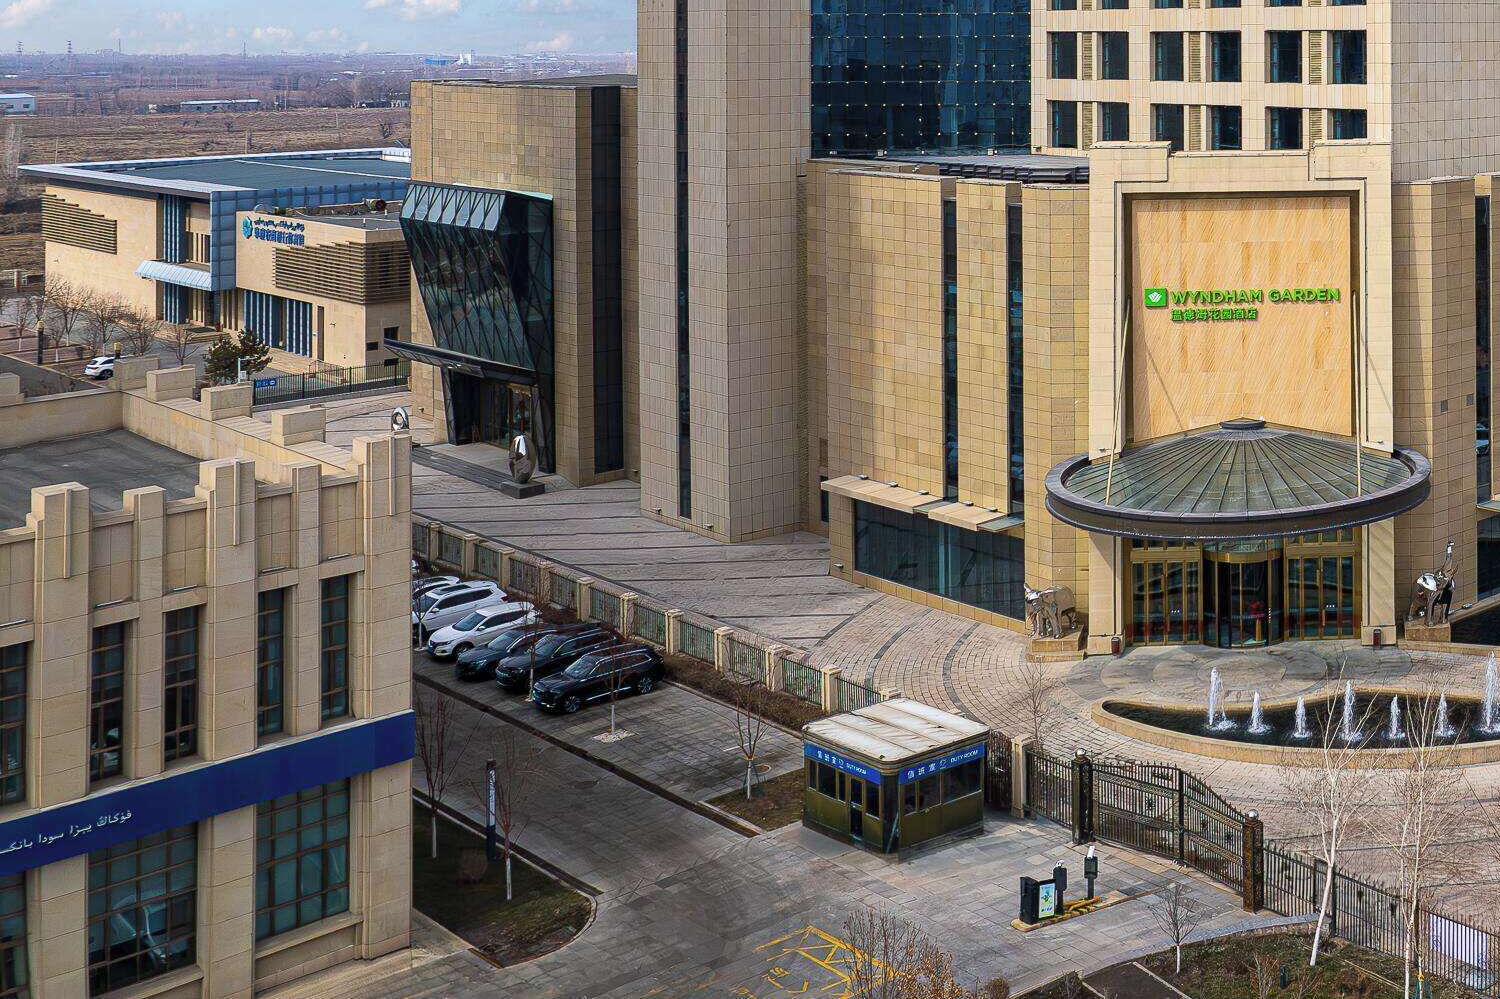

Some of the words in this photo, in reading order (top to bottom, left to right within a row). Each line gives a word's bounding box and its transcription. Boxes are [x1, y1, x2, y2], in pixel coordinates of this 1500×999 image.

[1170, 289, 1263, 304] WYNDHAM
[1268, 288, 1341, 302] GARDEN
[950, 754, 963, 763] DUTY
